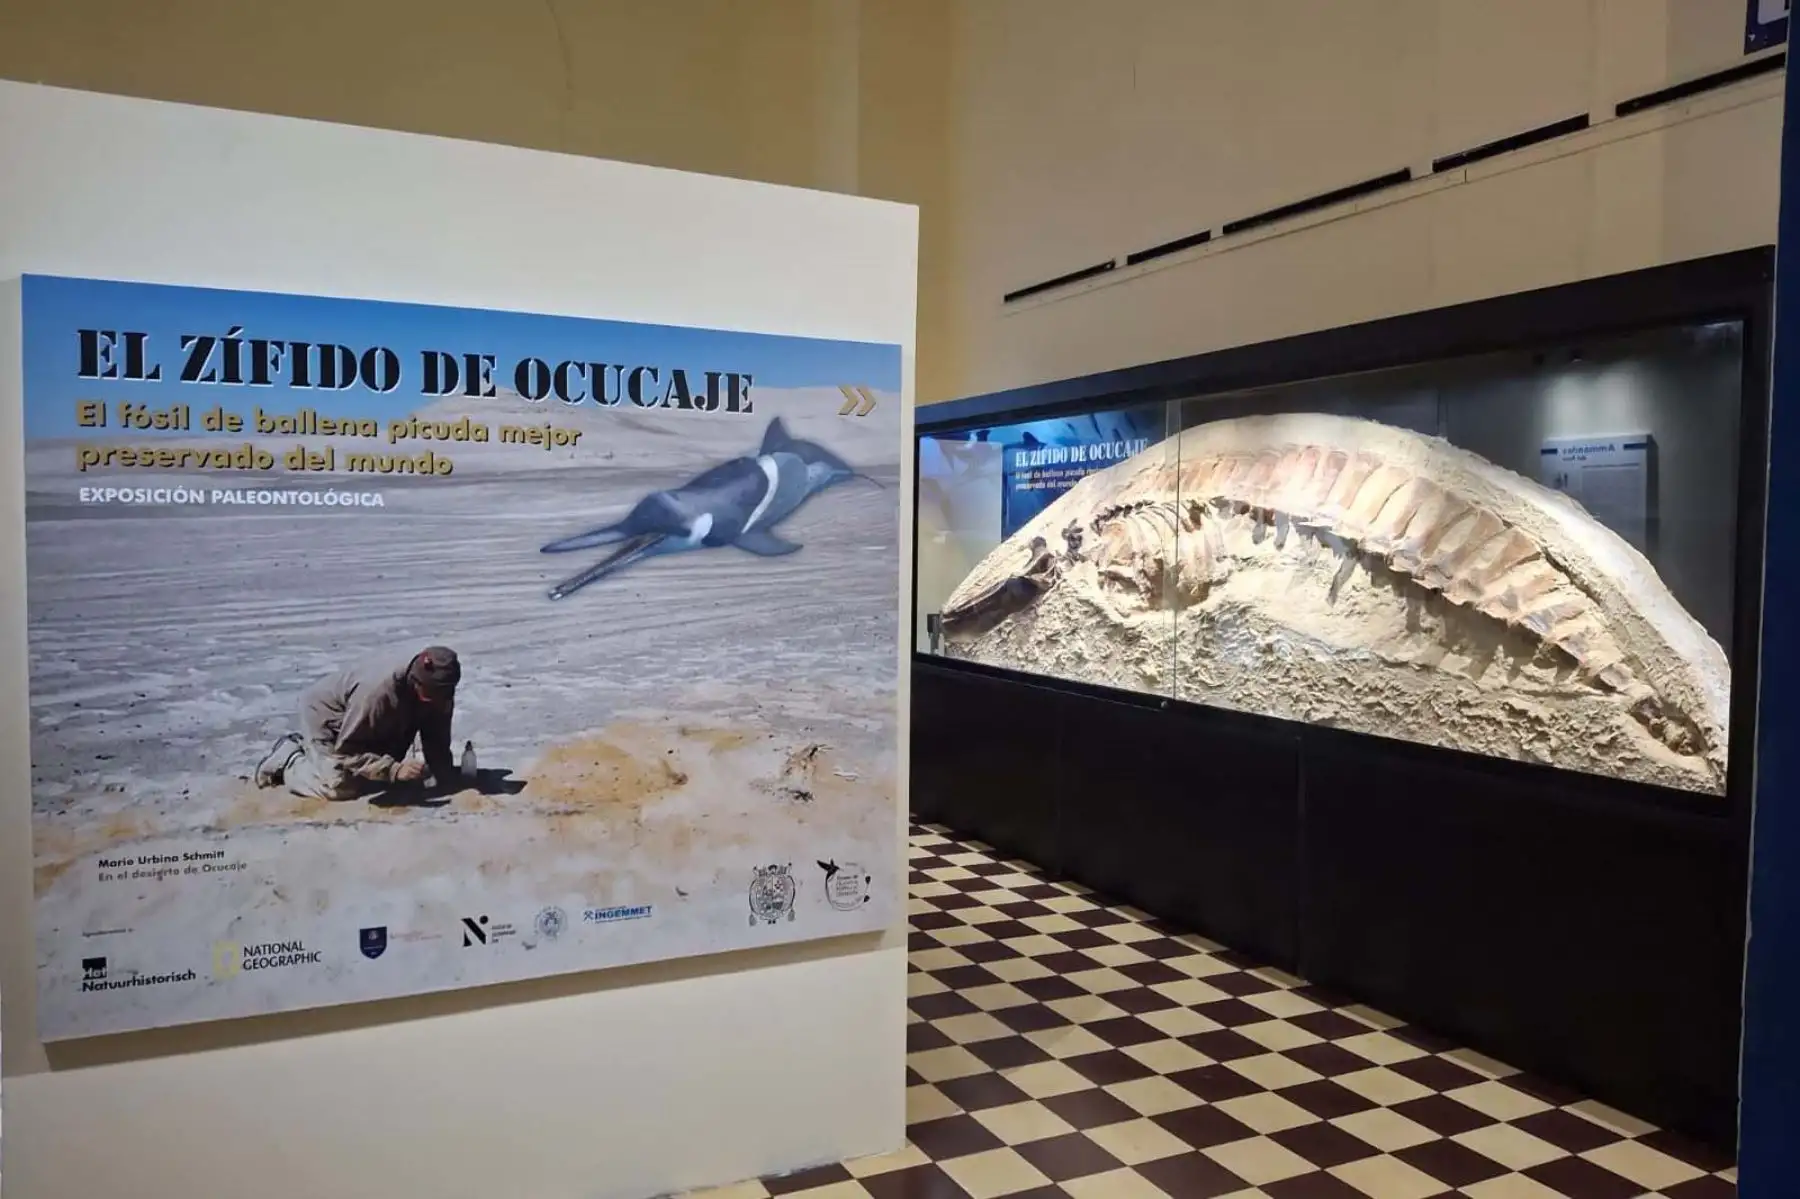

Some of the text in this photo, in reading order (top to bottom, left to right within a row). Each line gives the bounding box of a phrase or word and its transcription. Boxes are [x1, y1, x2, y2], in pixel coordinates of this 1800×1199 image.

[77, 326, 755, 415] EL ZÍFIDO DE OCUCAJE
[77, 401, 582, 450] El fósil de ballena picuda mejor
[77, 443, 453, 476] preservado del mundo
[1015, 451, 1029, 467] EL
[1030, 446, 1069, 466] ZÍFIDO
[1071, 445, 1086, 462] DE
[79, 485, 384, 507] EXPOSICIÓN PALEONTOLÓGICA
[98, 850, 225, 868] Mario Urbina Schmitt
[98, 872, 113, 882] En
[117, 870, 128, 880] el
[184, 865, 198, 874] de
[202, 860, 247, 873] Ocucaje
[595, 905, 652, 919] INGEMMET
[243, 940, 305, 957] NATIONAL
[242, 951, 322, 970] GEOGRAPHIC
[82, 969, 196, 992] Natuurhistorisch
